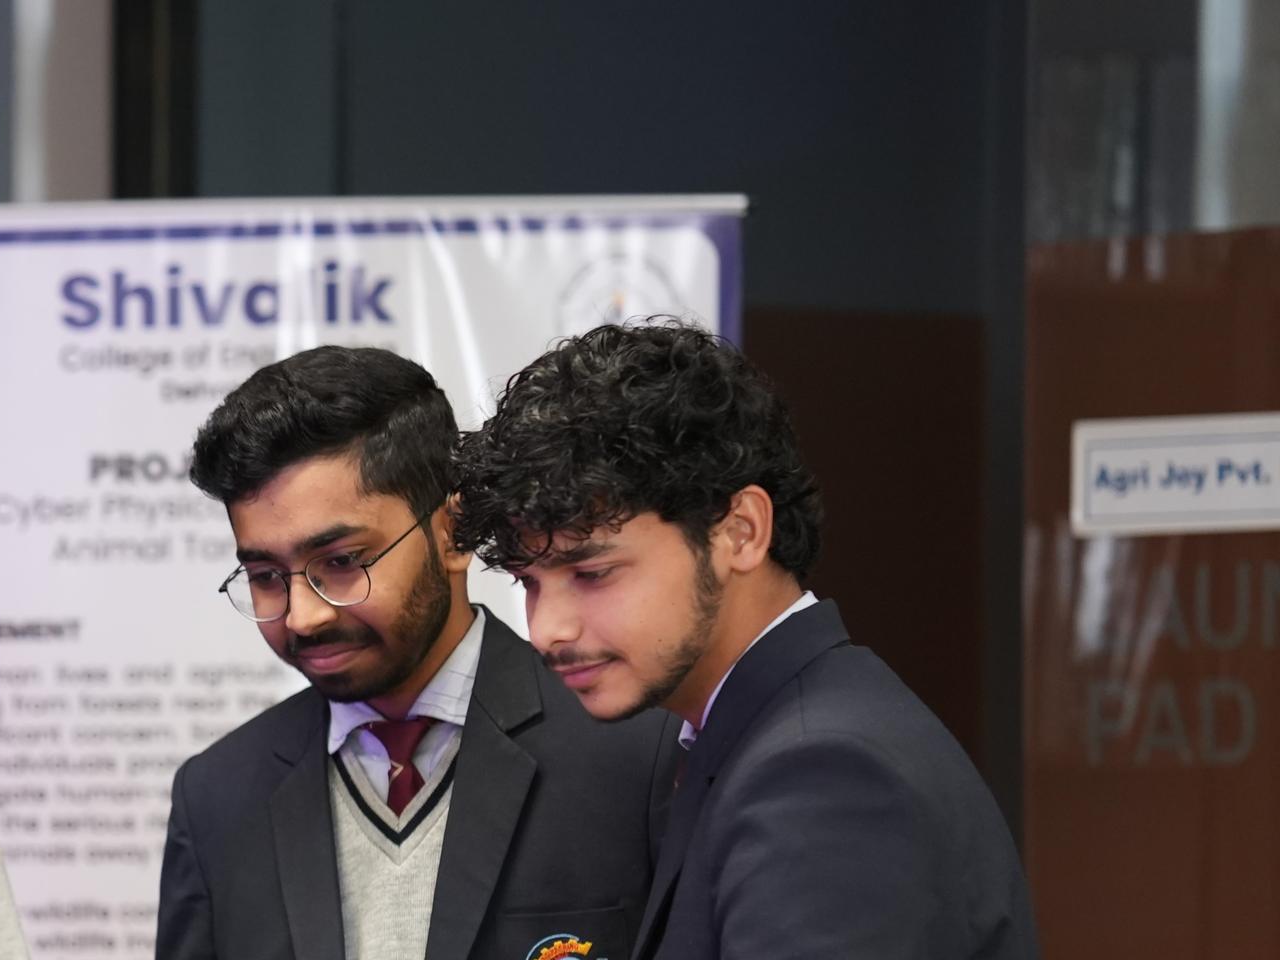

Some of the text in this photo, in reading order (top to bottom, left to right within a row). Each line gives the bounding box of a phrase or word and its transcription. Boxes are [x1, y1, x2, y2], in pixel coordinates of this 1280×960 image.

[60, 262, 394, 330] Shivaik
[1094, 456, 1271, 497] Agri Joy Pvt.
